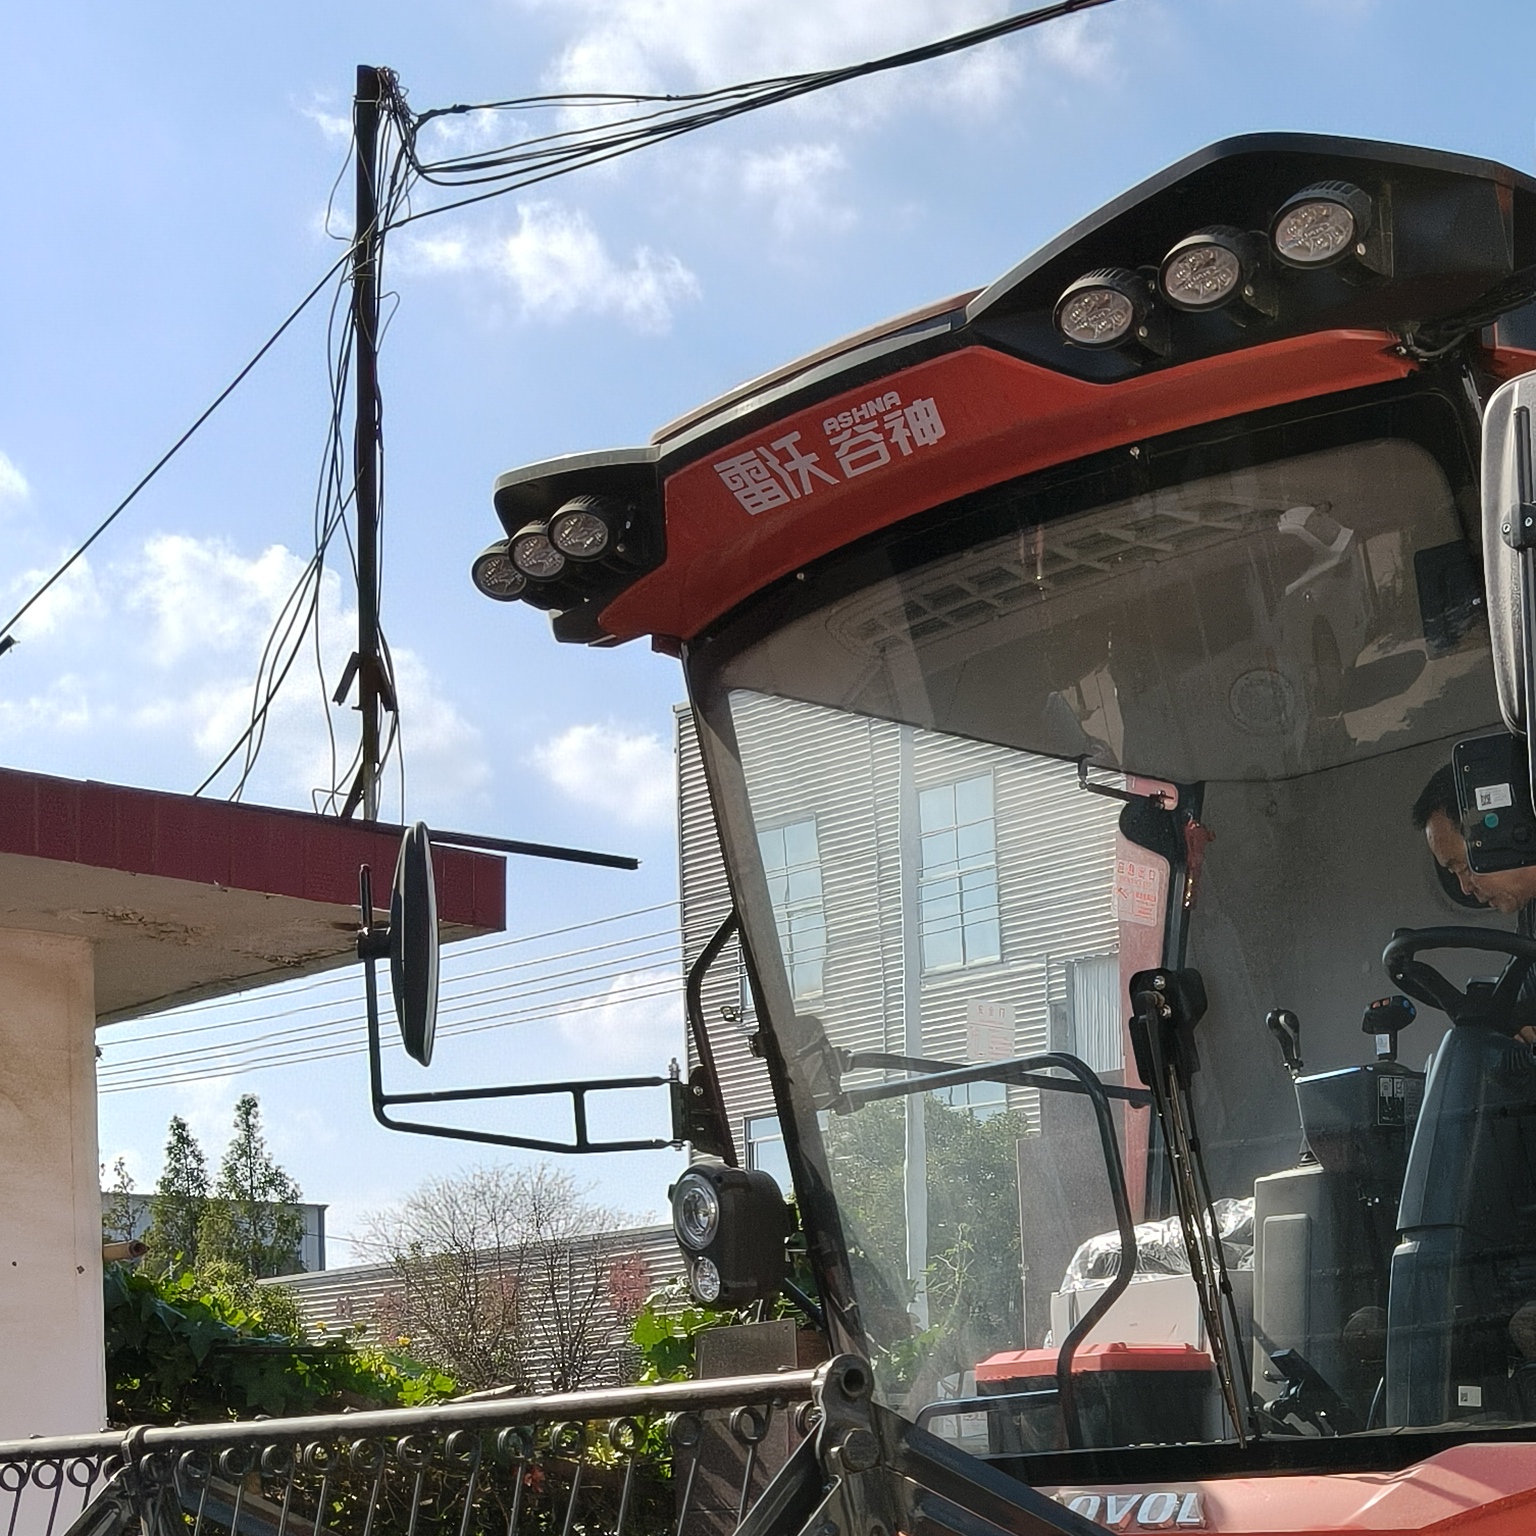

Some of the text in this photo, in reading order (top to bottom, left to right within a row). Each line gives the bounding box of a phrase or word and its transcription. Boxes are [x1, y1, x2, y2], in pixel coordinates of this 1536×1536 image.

[822, 391, 902, 435] ASHNA
[713, 397, 946, 515] 雷沃 谷神
